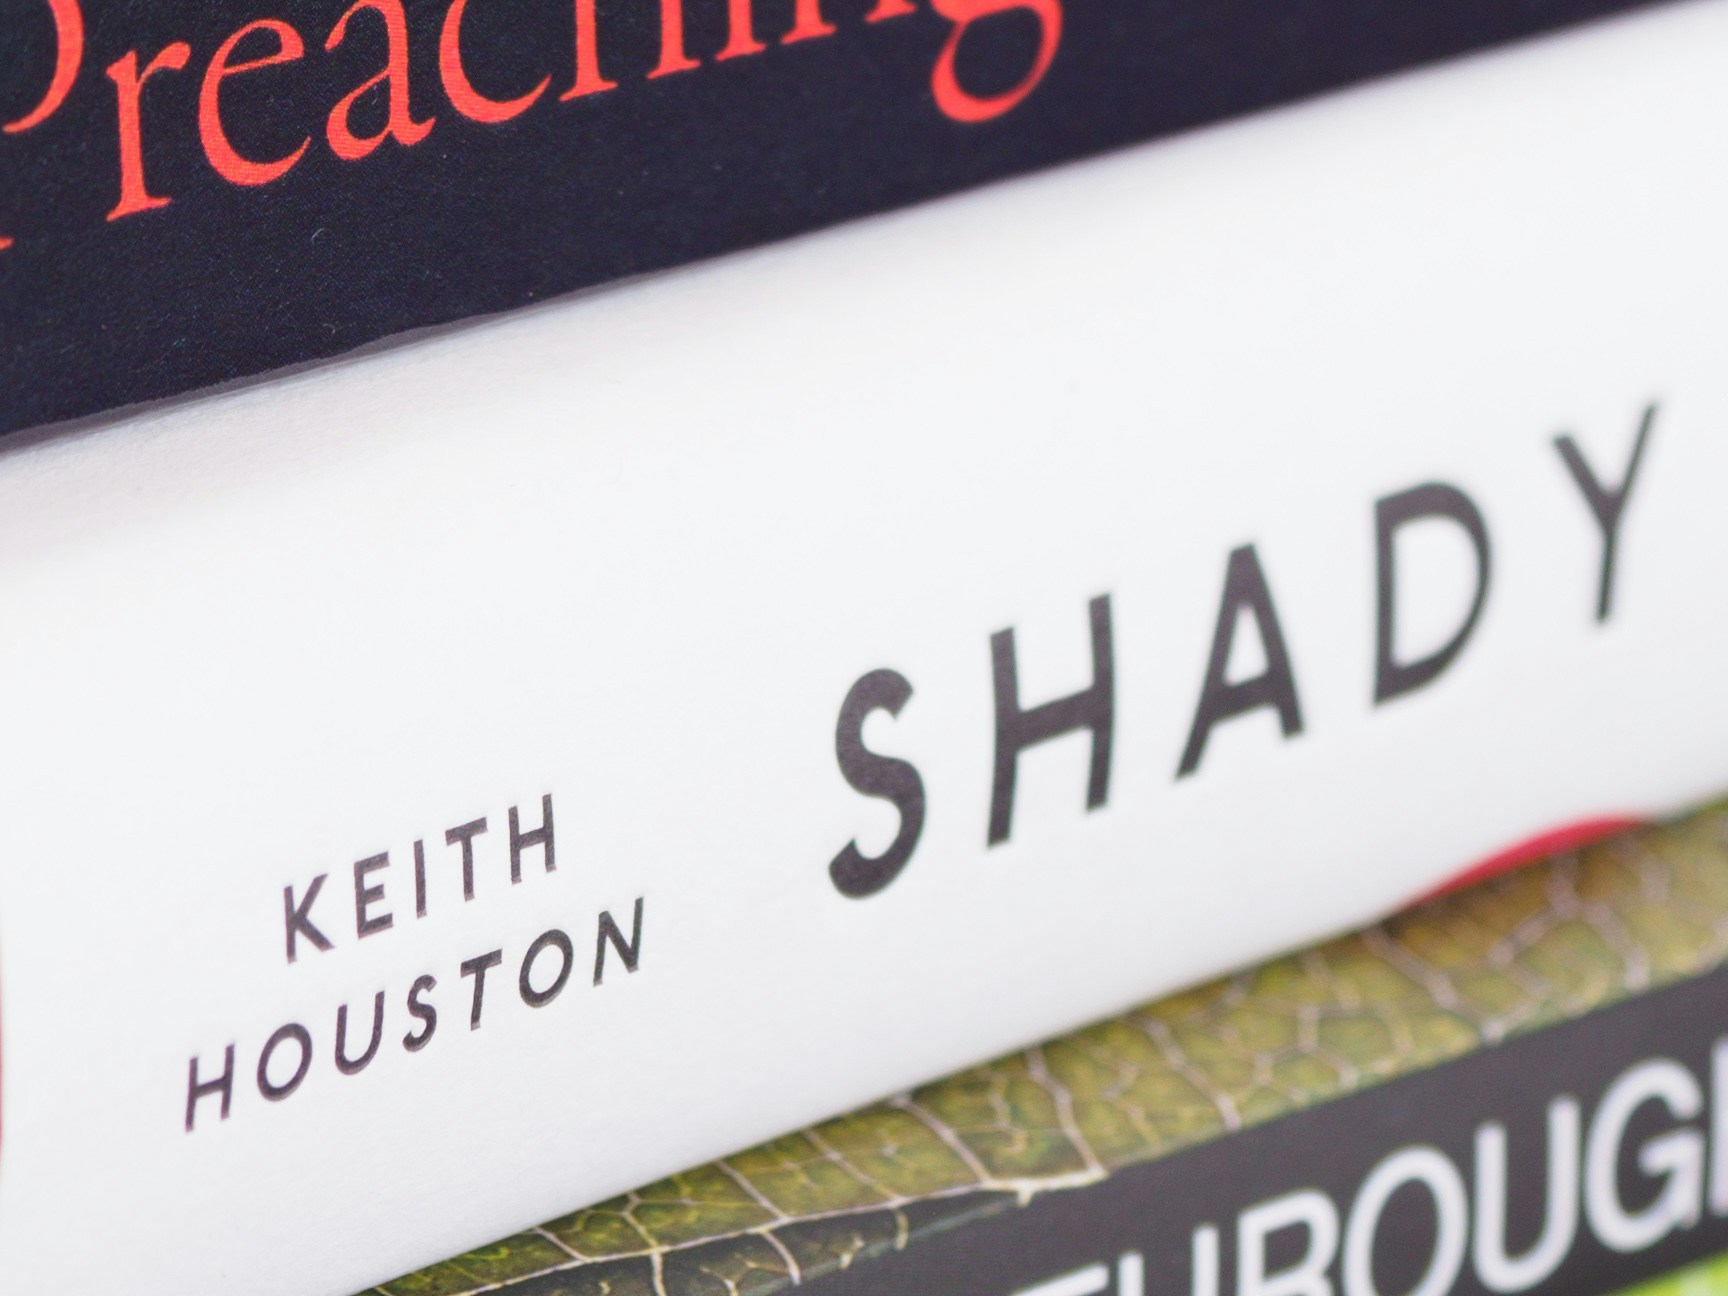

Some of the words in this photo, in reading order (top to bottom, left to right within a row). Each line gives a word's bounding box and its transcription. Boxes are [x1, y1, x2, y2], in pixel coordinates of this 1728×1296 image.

[827, 400, 1661, 903] SHADY
[281, 790, 562, 967] KEITH
[183, 896, 650, 1134] HOUSTON
